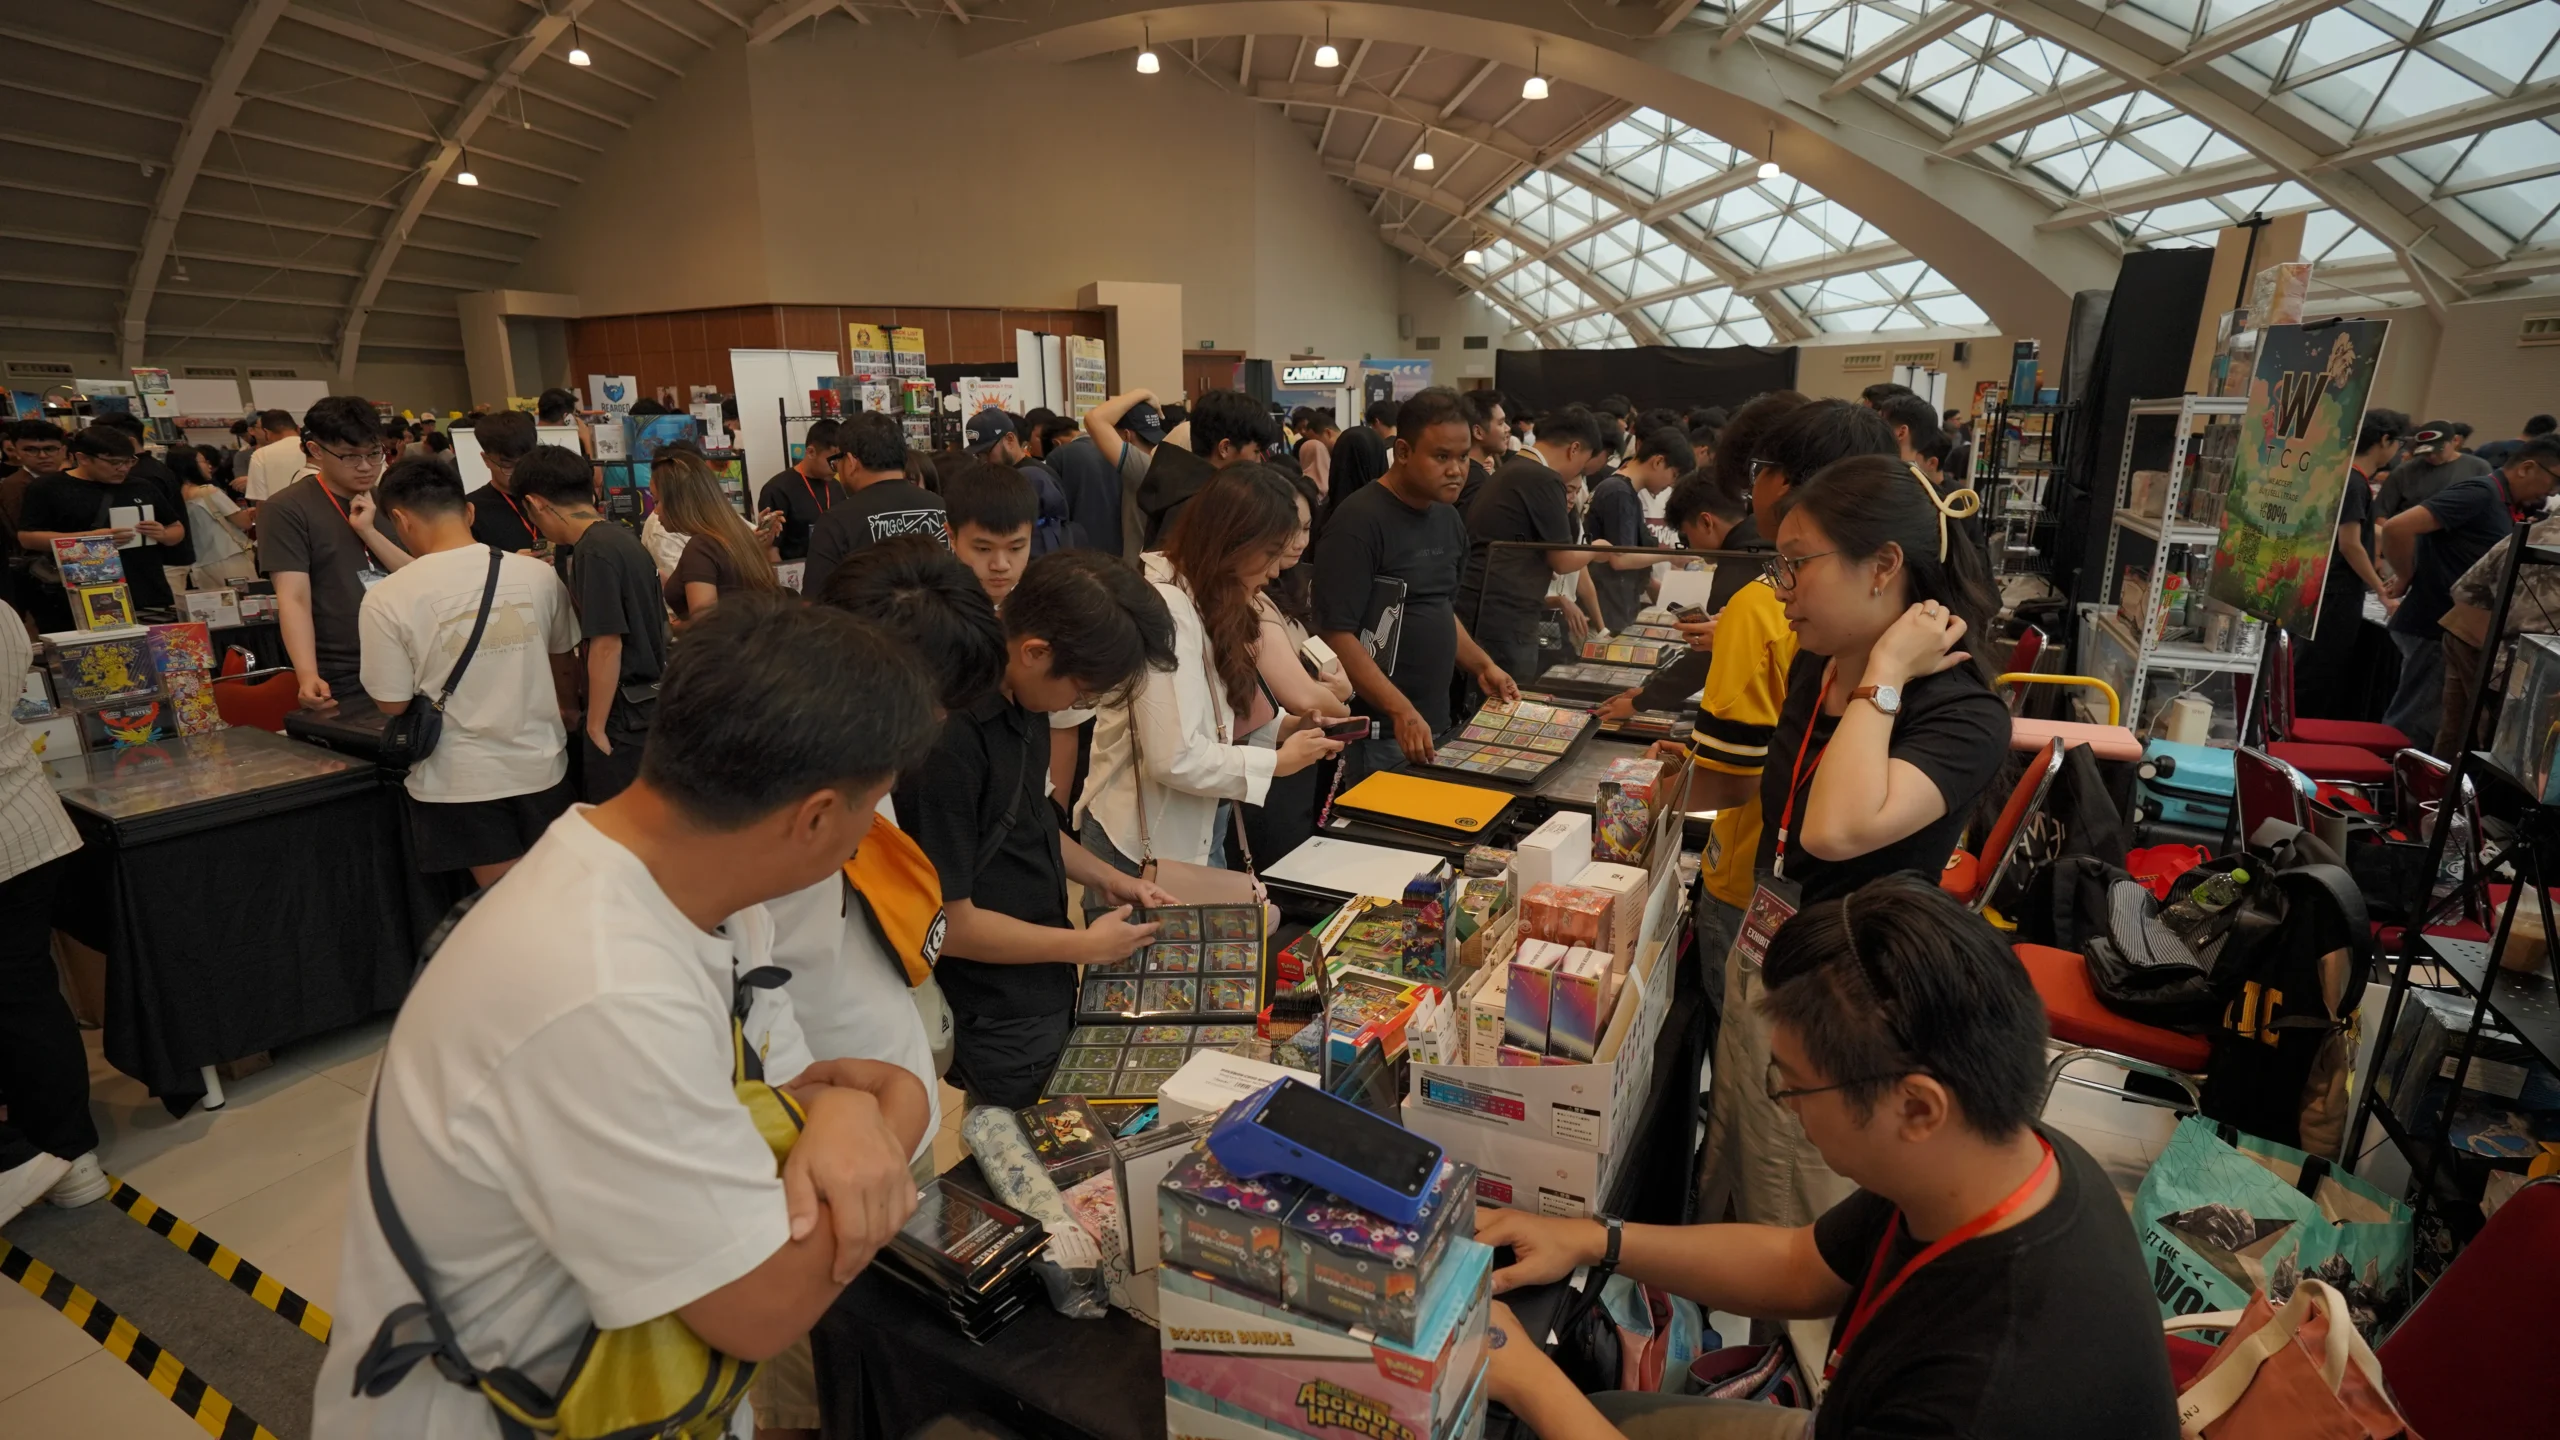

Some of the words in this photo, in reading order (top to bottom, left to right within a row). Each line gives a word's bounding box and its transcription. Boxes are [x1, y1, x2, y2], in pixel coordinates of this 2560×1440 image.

[1283, 366, 1346, 384] CARDFUN
[601, 403, 631, 413] BEARDED
[2276, 370, 2331, 440] W
[2275, 479, 2293, 488] ACCEPT
[2283, 492, 2299, 502] TRADE
[2266, 503, 2287, 524] 80%
[1746, 927, 1771, 949] EXHIBIT
[971, 1232, 1015, 1266] theKRAKEN
[2158, 1238, 2180, 1263] THE
[1168, 1327, 1236, 1345] BOOSTER
[1237, 1328, 1295, 1347] BUNDLE
[1296, 1382, 1416, 1440] ASCENDED
[1307, 1404, 1397, 1440] HEROES
